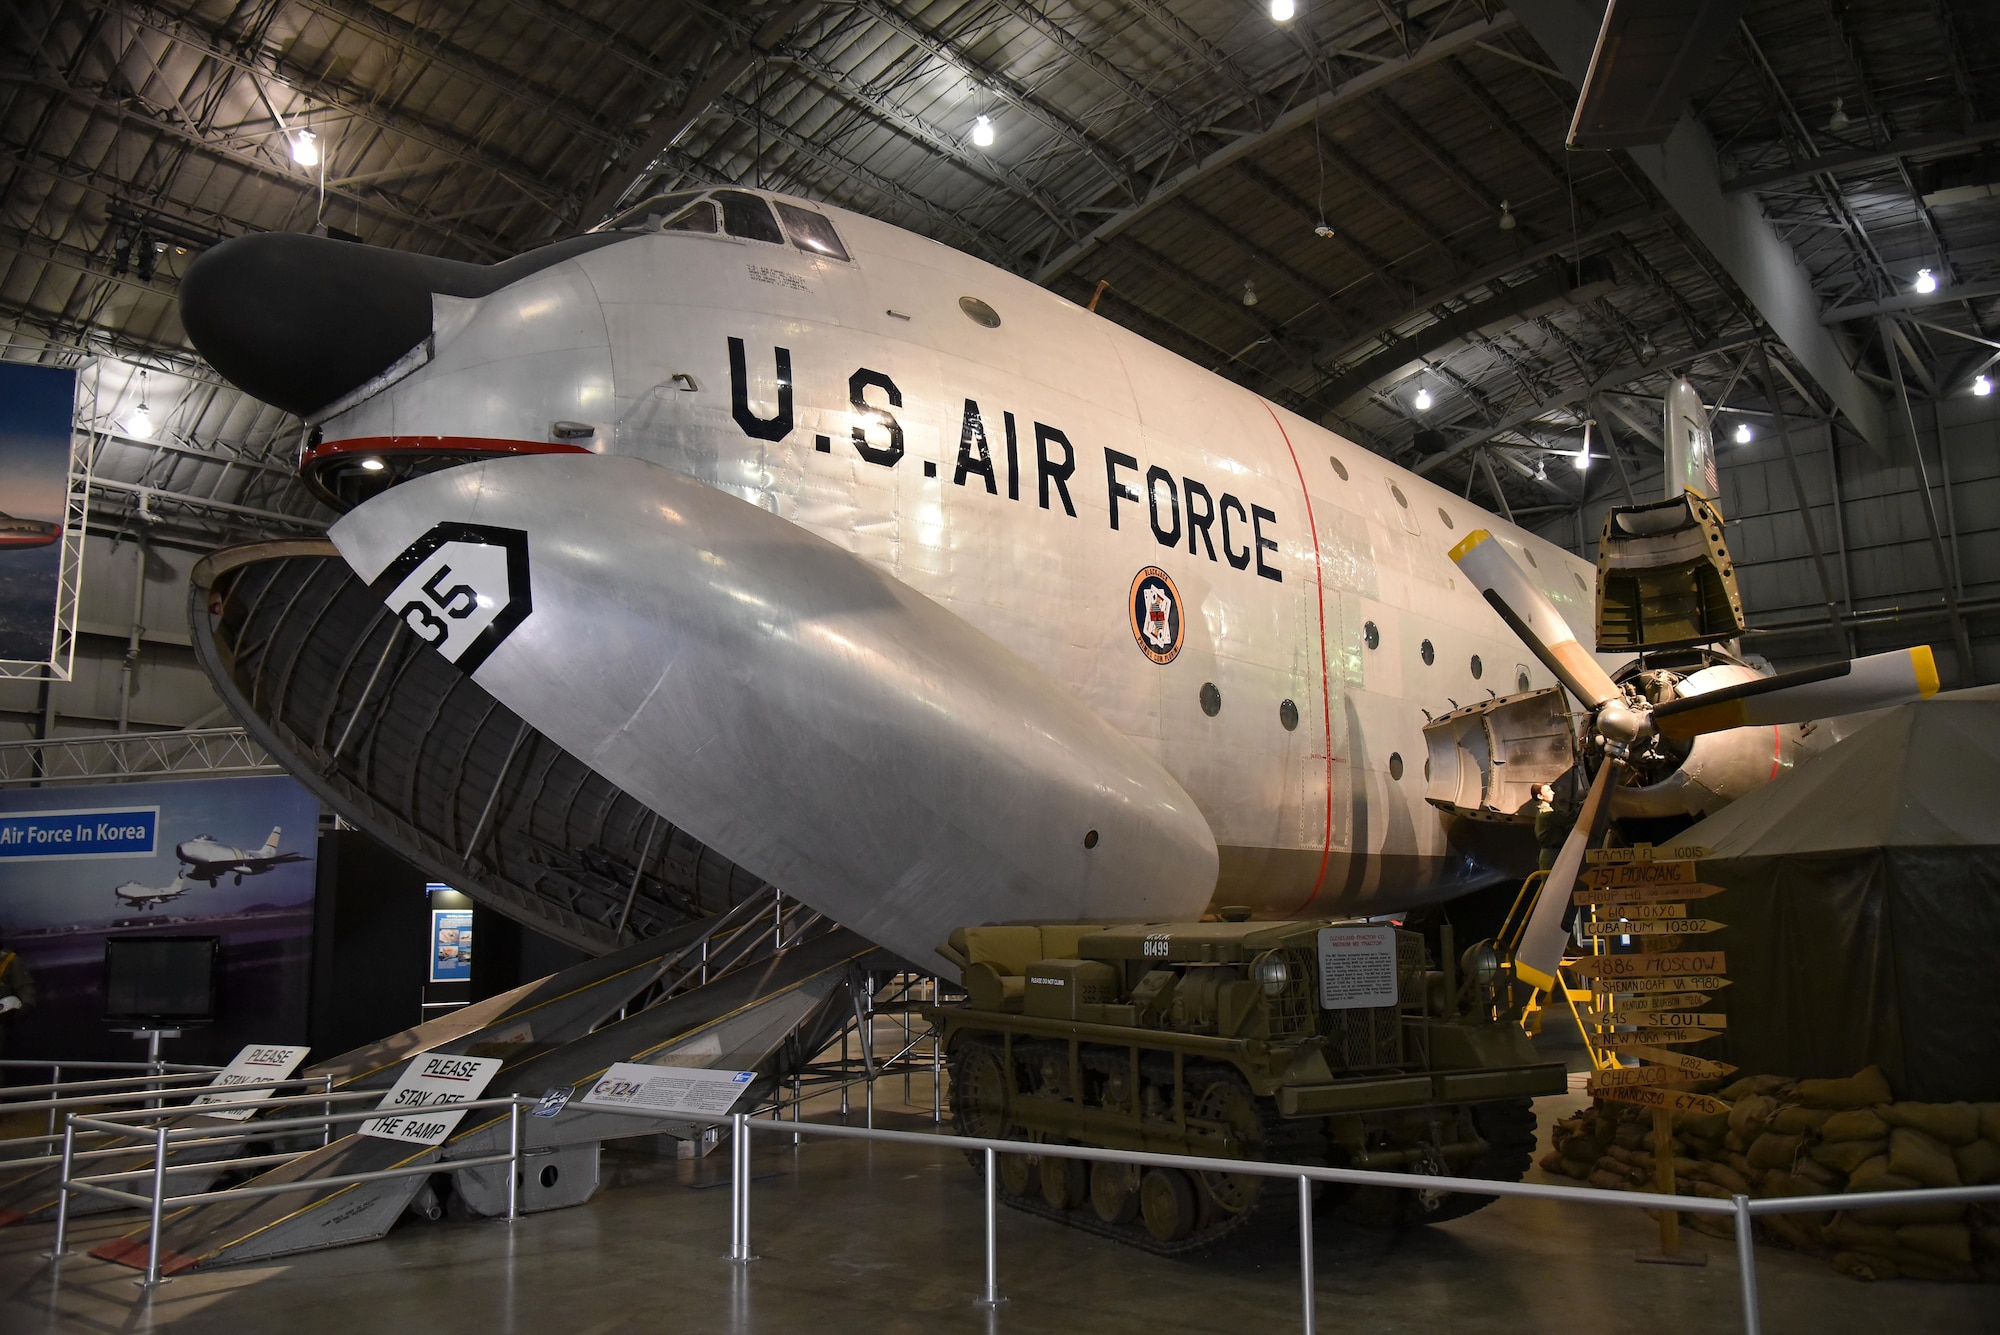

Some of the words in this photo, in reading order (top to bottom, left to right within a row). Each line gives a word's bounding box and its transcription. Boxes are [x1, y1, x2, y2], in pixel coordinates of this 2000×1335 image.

[727, 336, 937, 478] U.S.
[953, 398, 1078, 518] AIR
[1103, 446, 1283, 583] FORCE
[1144, 568, 1168, 582] BLACKJACK
[398, 564, 478, 649] 35
[0, 827, 24, 845] Air
[27, 826, 73, 844] Force
[76, 824, 93, 842] In
[97, 823, 146, 841] Korea
[1595, 850, 1635, 860] TAMPA
[1643, 848, 1657, 859] FL
[1675, 846, 1704, 858] 10015
[1593, 868, 1615, 885] 757
[1621, 864, 1681, 882] PYONGYANG
[1625, 889, 1641, 901] HQ
[1608, 905, 1625, 918] 610
[1636, 905, 1675, 917] TOKYO
[1588, 922, 1620, 934] CUBA
[1625, 921, 1654, 933] RUM
[1665, 920, 1708, 933] 10302
[1143, 941, 1169, 956] 81499
[1591, 959, 1634, 975] 4886
[1646, 956, 1716, 972] MOSCOW
[1602, 979, 1665, 993] SHENANDOAH
[1674, 979, 1685, 990] VA
[1691, 977, 1720, 989] 9980
[1602, 1012, 1627, 1024] 645
[1648, 1013, 1706, 1026] SEOUL
[1603, 1034, 1628, 1045] NEW
[1633, 1032, 1659, 1045] YORK
[1664, 1031, 1687, 1041] 9916
[247, 1049, 293, 1063] PLEASE
[1681, 1057, 1702, 1070] 1282
[424, 1059, 482, 1078] PLEASE
[1601, 1067, 1667, 1087] CHICAGO
[593, 1079, 643, 1098] C-124
[395, 1089, 433, 1106] STAY
[1613, 1087, 1664, 1105] FRANCISCO
[1676, 1096, 1716, 1114] 6745
[371, 1117, 403, 1135] THE
[401, 1121, 446, 1140] RAMP
